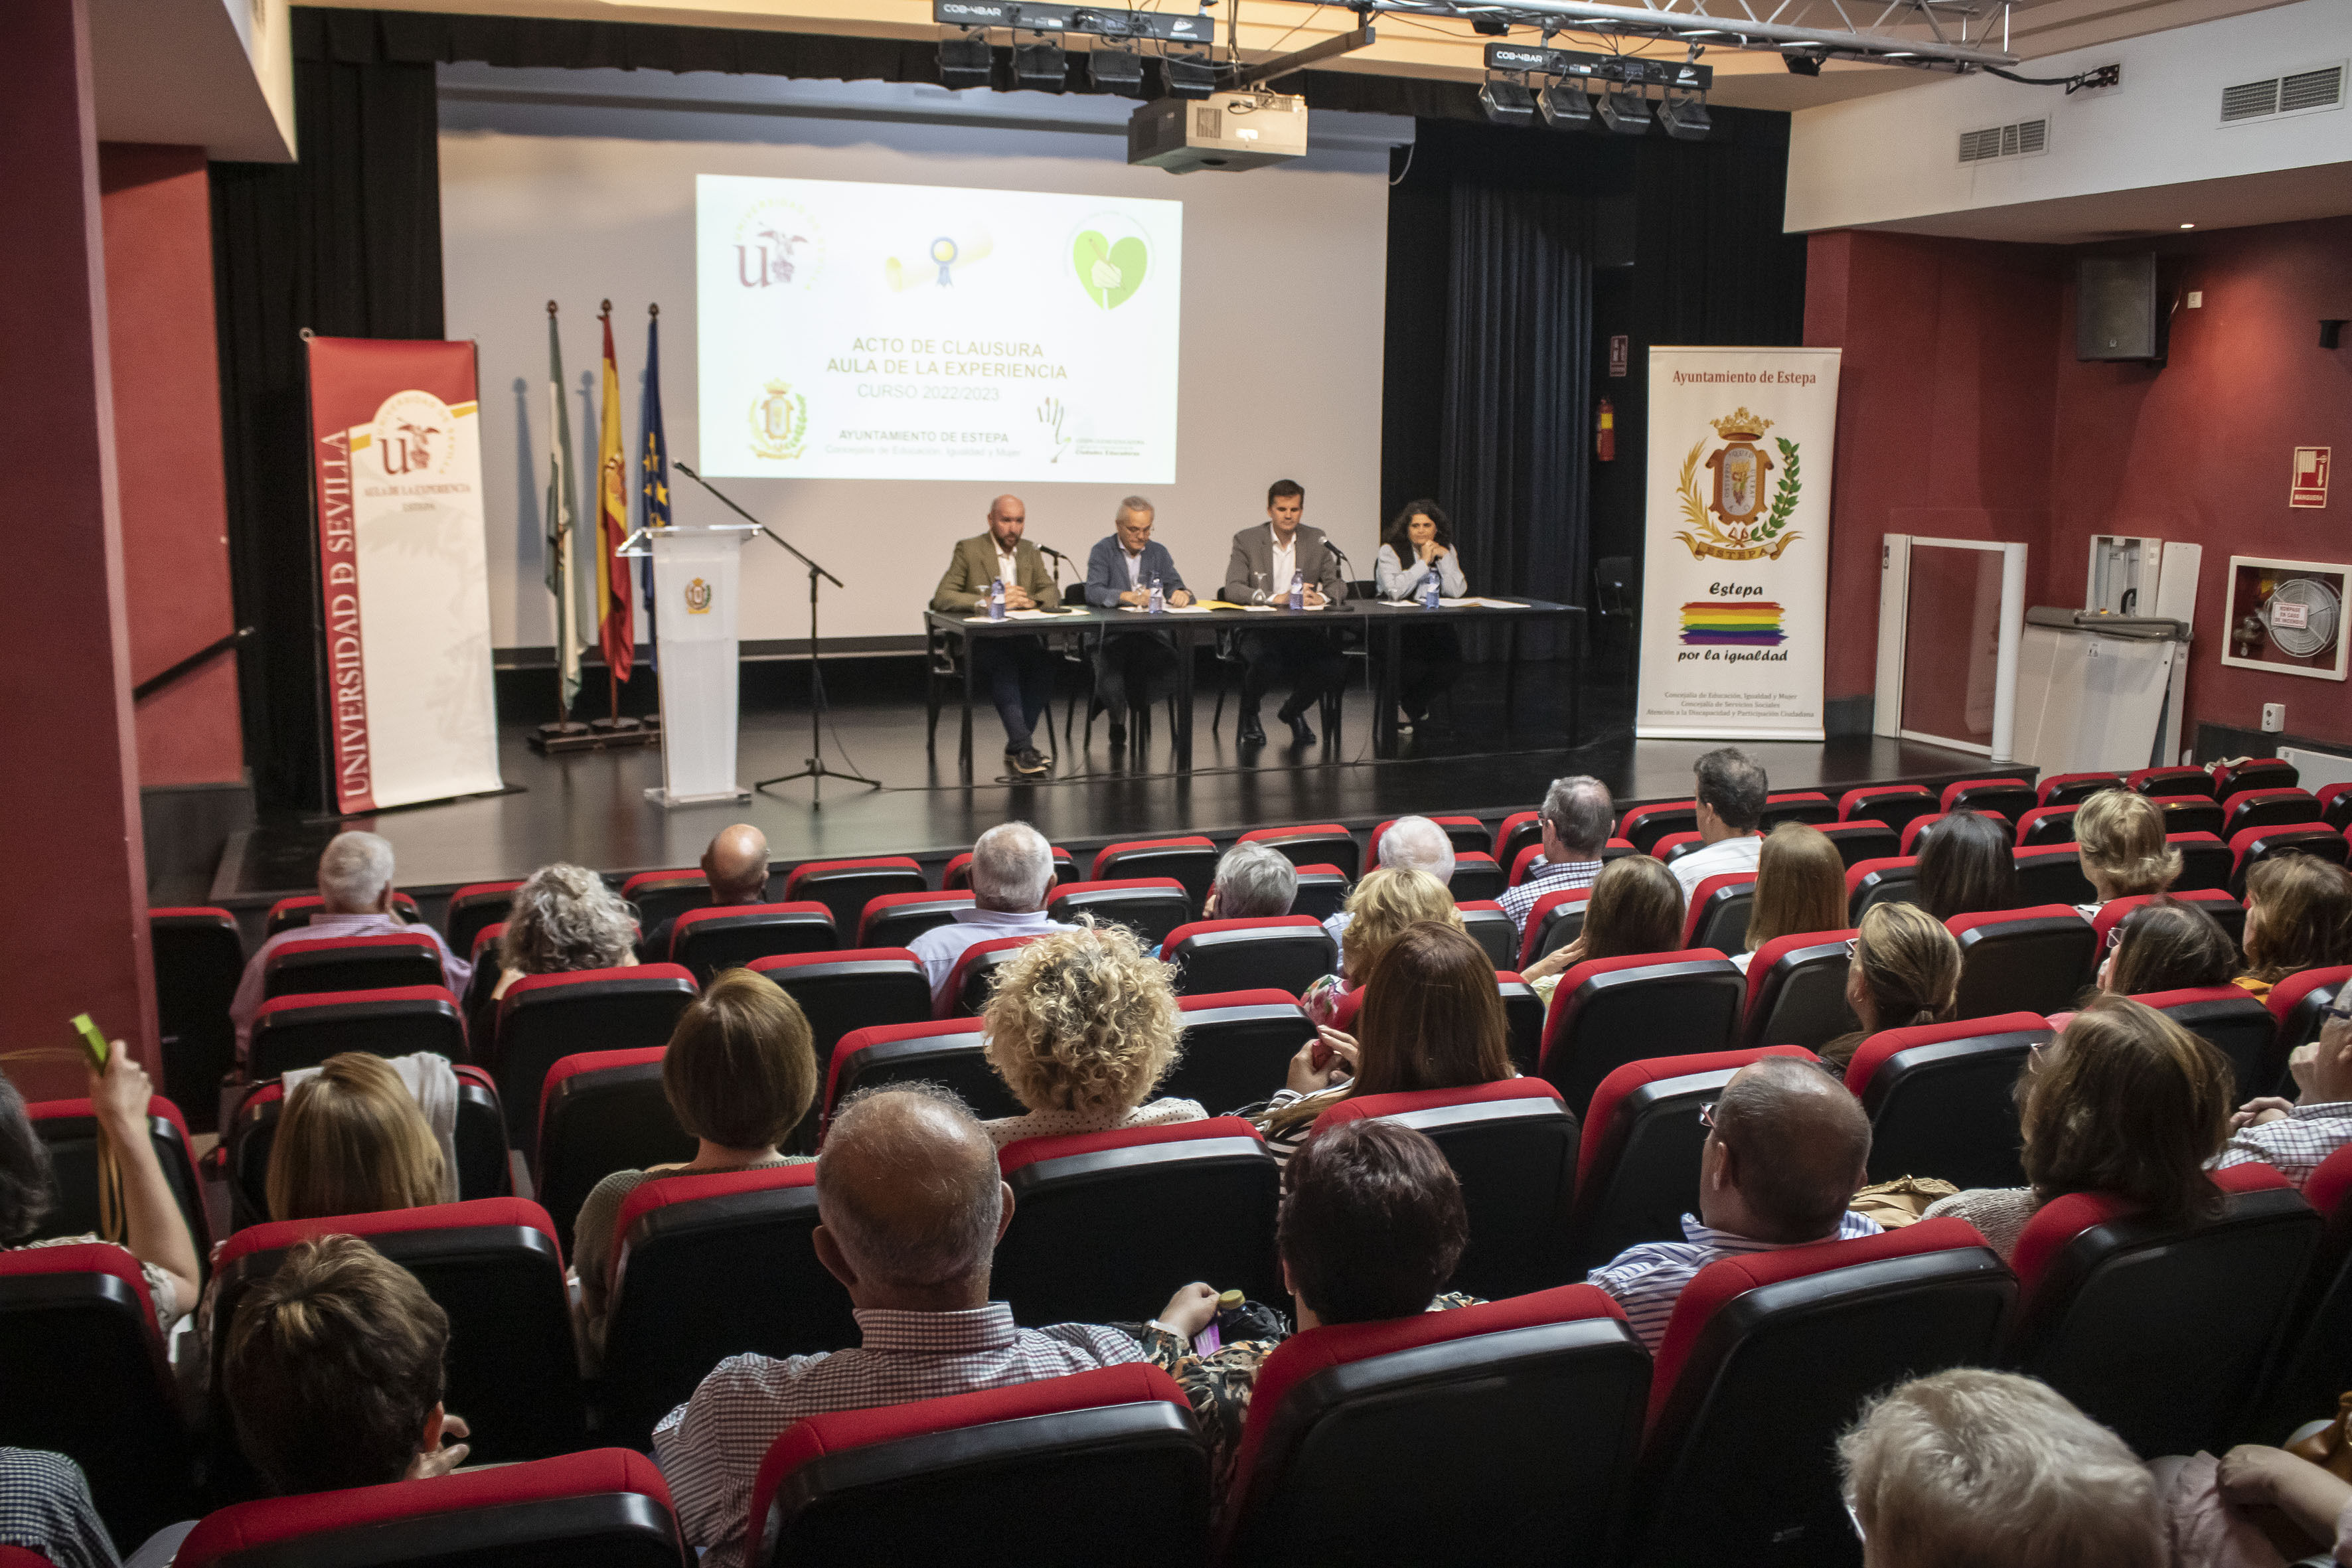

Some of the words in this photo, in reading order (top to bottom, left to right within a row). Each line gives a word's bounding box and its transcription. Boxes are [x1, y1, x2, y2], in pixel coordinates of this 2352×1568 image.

[852, 337, 904, 353] ACTO
[911, 339, 936, 355] DE
[942, 339, 1044, 358] CLAUSURA
[826, 358, 878, 374] AULA
[884, 358, 909, 374] DE
[915, 360, 939, 375] LA
[945, 360, 1068, 380] EXPERIENCIA
[1673, 370, 1757, 384] Ayuntamiento
[1760, 371, 1773, 383] de
[1776, 371, 1816, 387] Estepa
[857, 384, 917, 399] CURSO
[923, 386, 1000, 402] 2022/2023
[838, 430, 936, 441] AYUNTAMIENTO
[941, 431, 957, 442] DE
[961, 432, 1009, 443] ESTEPA
[321, 431, 354, 552] SEVILLA
[1706, 546, 1767, 559] ESTEPA
[1709, 582, 1764, 597] Estepa
[1678, 651, 1700, 663] por
[1704, 649, 1721, 662] la
[1723, 649, 1788, 663] igualdad
[332, 594, 369, 797] UNIVERSIDAD
